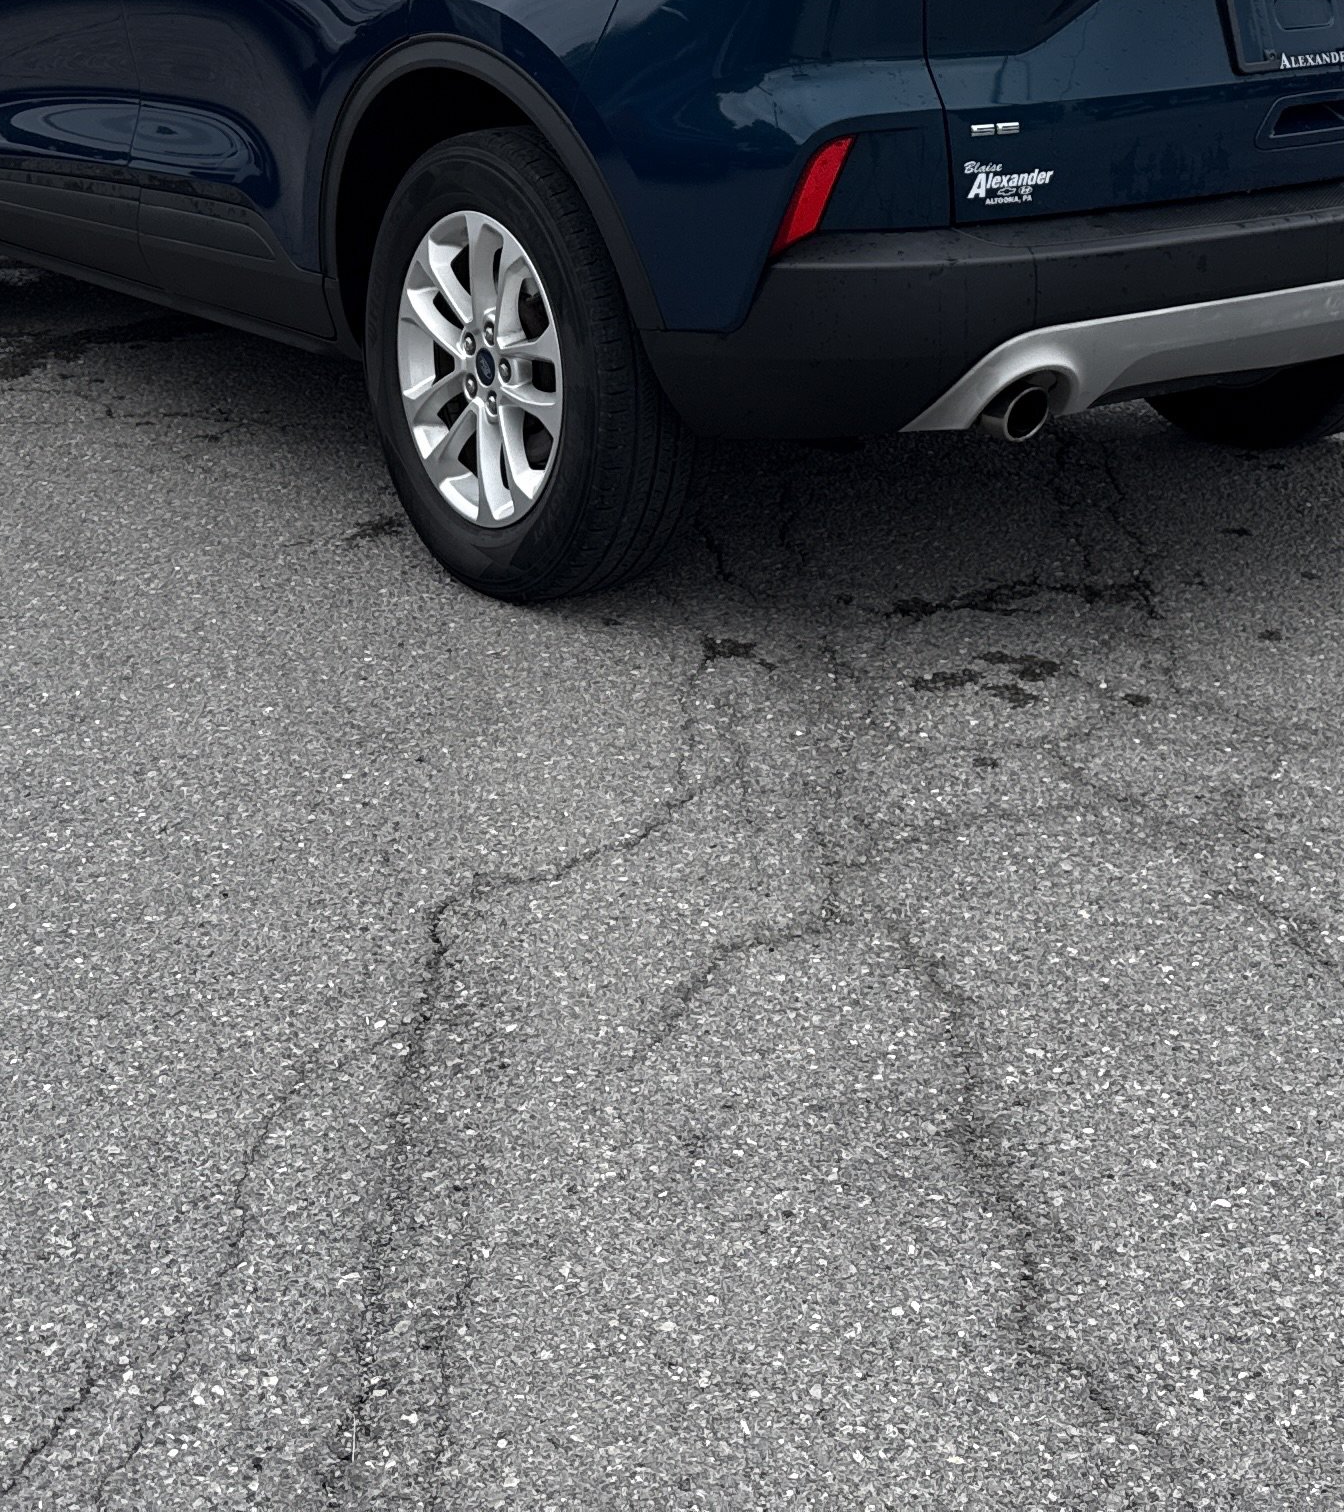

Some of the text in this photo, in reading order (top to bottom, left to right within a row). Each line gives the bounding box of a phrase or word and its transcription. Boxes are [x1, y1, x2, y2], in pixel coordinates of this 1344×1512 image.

[971, 122, 1020, 137] SE
[964, 161, 1003, 174] Blaise
[967, 168, 1055, 199] Alexander
